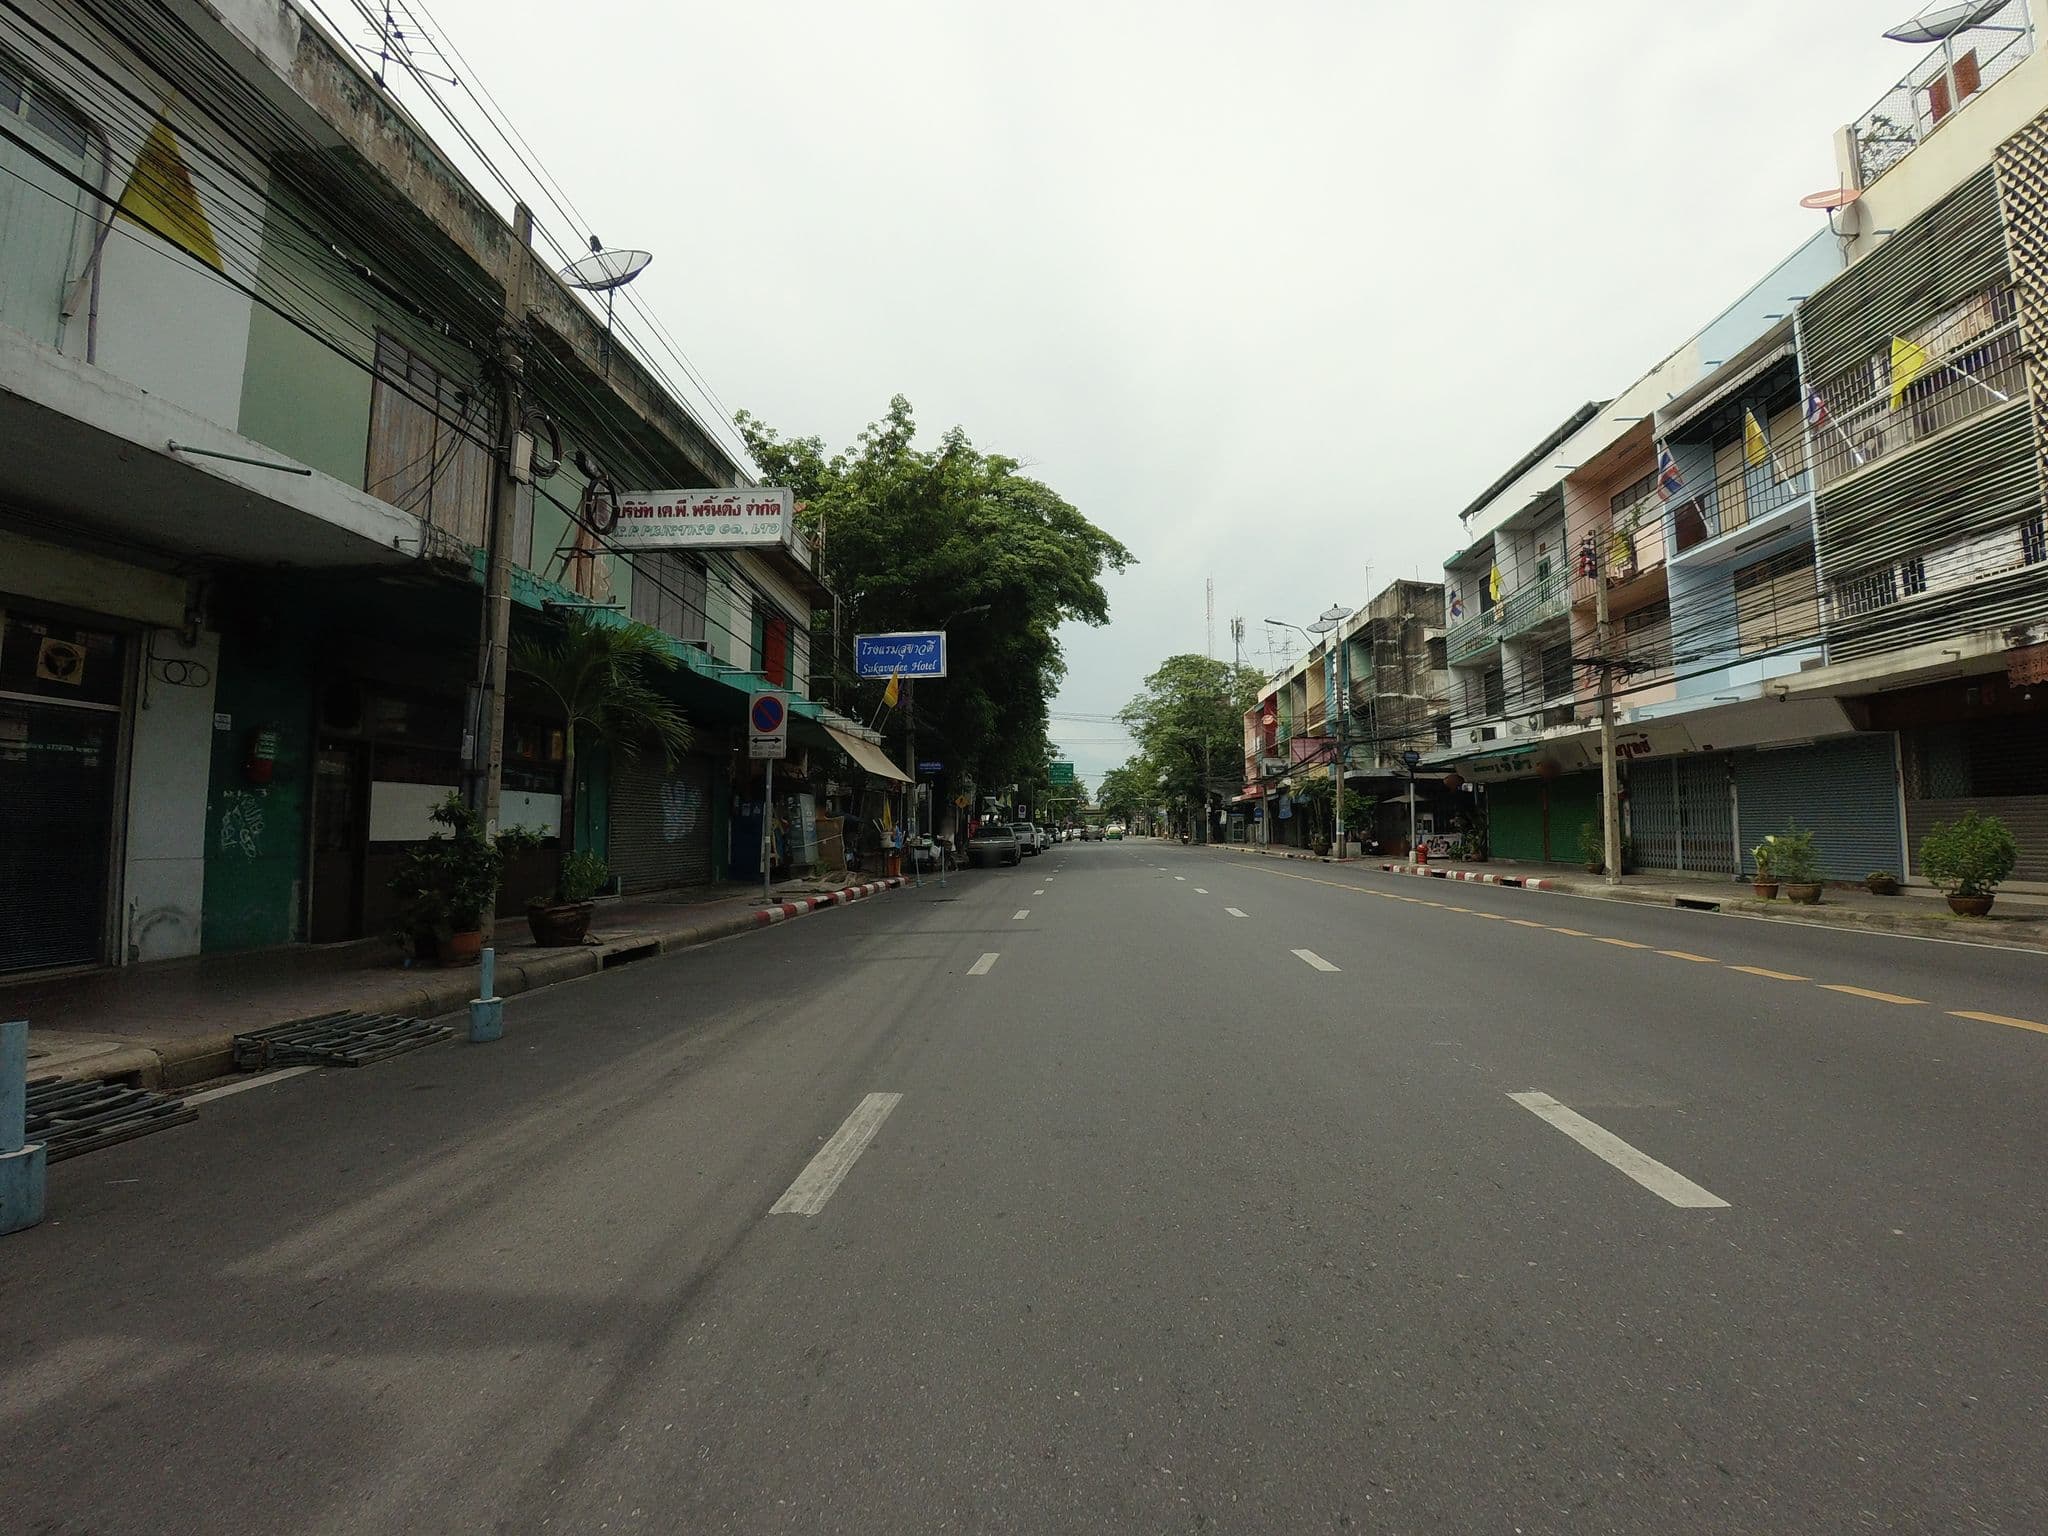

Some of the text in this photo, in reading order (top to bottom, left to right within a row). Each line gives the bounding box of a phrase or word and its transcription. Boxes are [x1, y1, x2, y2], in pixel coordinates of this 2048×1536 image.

[616, 500, 654, 518] บริษัท
[692, 495, 742, 517] พริ้นติ้ง
[746, 498, 781, 516] จำกัด
[862, 639, 936, 660] โรงแรมสุขาวดี
[862, 659, 937, 674] Sukavadee Hotel
